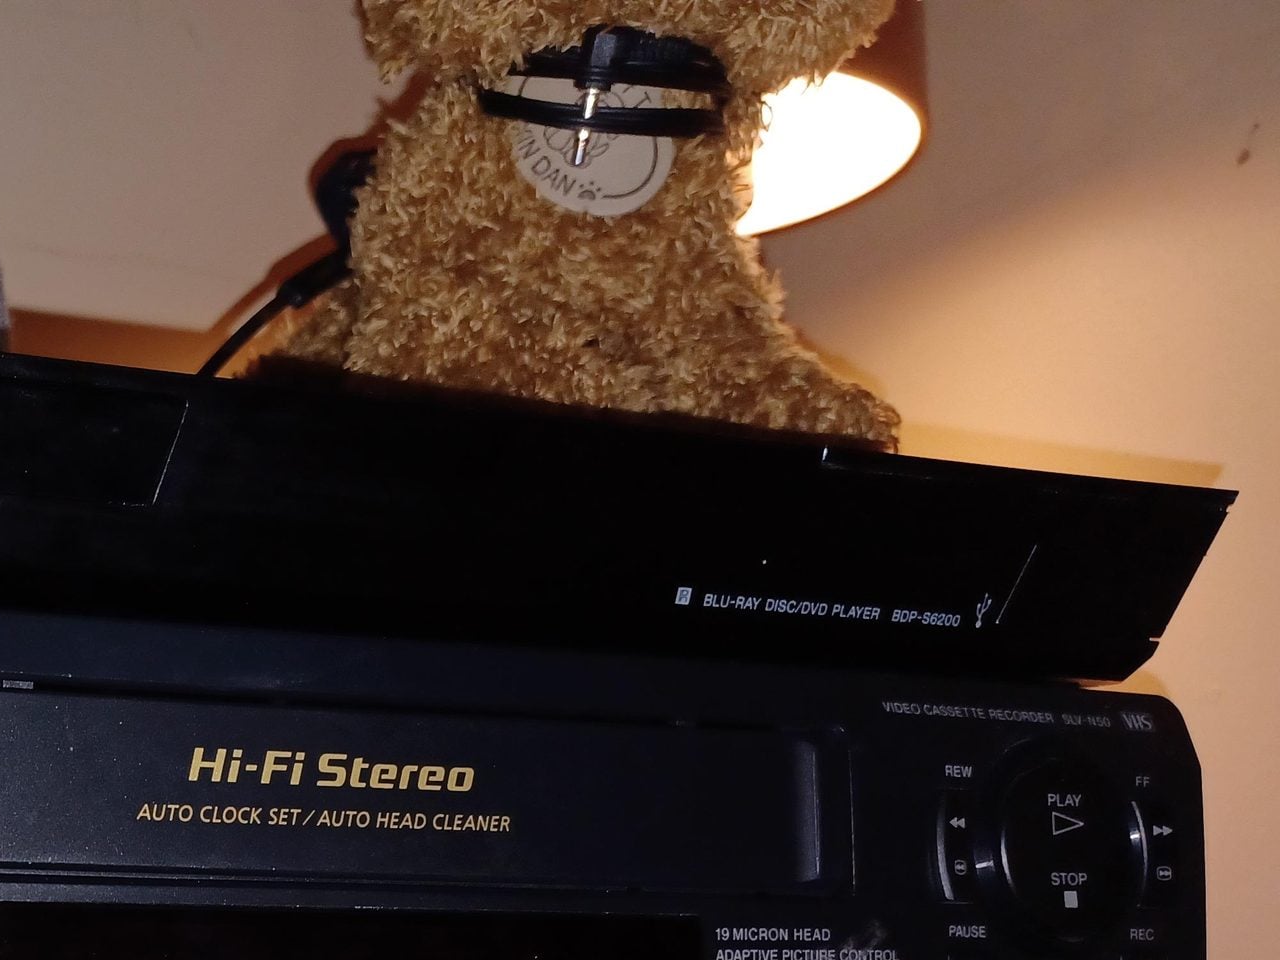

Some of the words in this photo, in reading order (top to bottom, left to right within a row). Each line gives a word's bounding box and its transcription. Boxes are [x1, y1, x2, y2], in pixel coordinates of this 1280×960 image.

[703, 593, 761, 611] BLU-RAY
[764, 598, 828, 617] DISC/DVD
[831, 603, 881, 621] PLAYER
[891, 608, 961, 628] BDP-S6200
[882, 701, 921, 715] VIDEO
[923, 703, 986, 721] CASSETTE
[988, 708, 1055, 724] RECORDER
[1122, 713, 1153, 730] VHS
[188, 746, 306, 786] Hi-Fi
[316, 752, 475, 793] Stereo
[945, 765, 972, 778] REW
[1135, 776, 1150, 788] FF
[1047, 794, 1082, 807] PLAY
[136, 803, 194, 823] AUTO
[200, 805, 261, 826] CLOCK
[376, 812, 427, 831] HEAD
[432, 813, 511, 833] CLEANER
[1050, 872, 1088, 886] STOP
[715, 927, 730, 941] 19
[733, 927, 789, 942] MICRON
[793, 928, 831, 941] HEAD
[948, 925, 986, 938] PAUSE
[1130, 928, 1155, 942] REC
